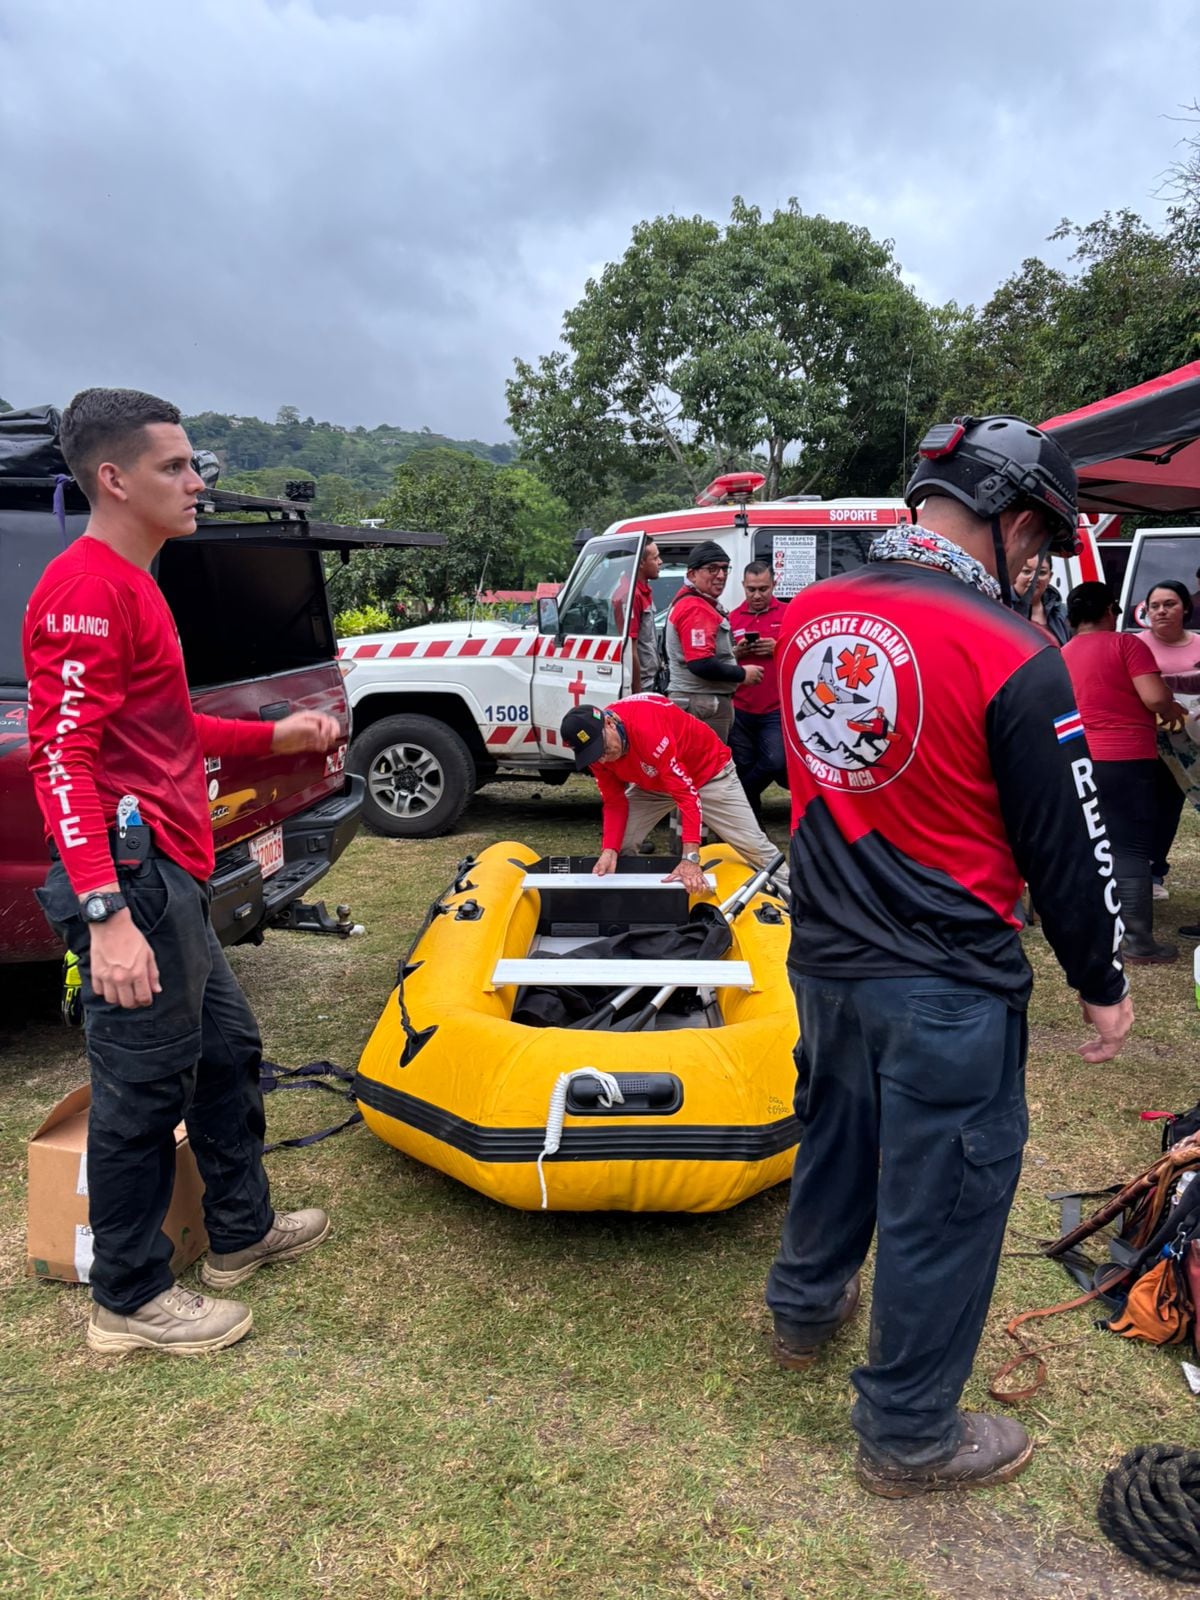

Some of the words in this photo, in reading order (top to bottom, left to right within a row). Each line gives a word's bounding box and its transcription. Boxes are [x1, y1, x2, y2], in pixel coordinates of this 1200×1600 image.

[829, 509, 878, 521] SOPORTE
[47, 613, 60, 633] H.
[63, 614, 110, 638] BLANCO
[794, 617, 860, 652] RESCATE
[859, 619, 910, 668] URBANO
[484, 704, 530, 722] 1508
[804, 753, 843, 784] COSTA
[847, 769, 876, 788] RICA
[1070, 757, 1126, 971] RESCA
